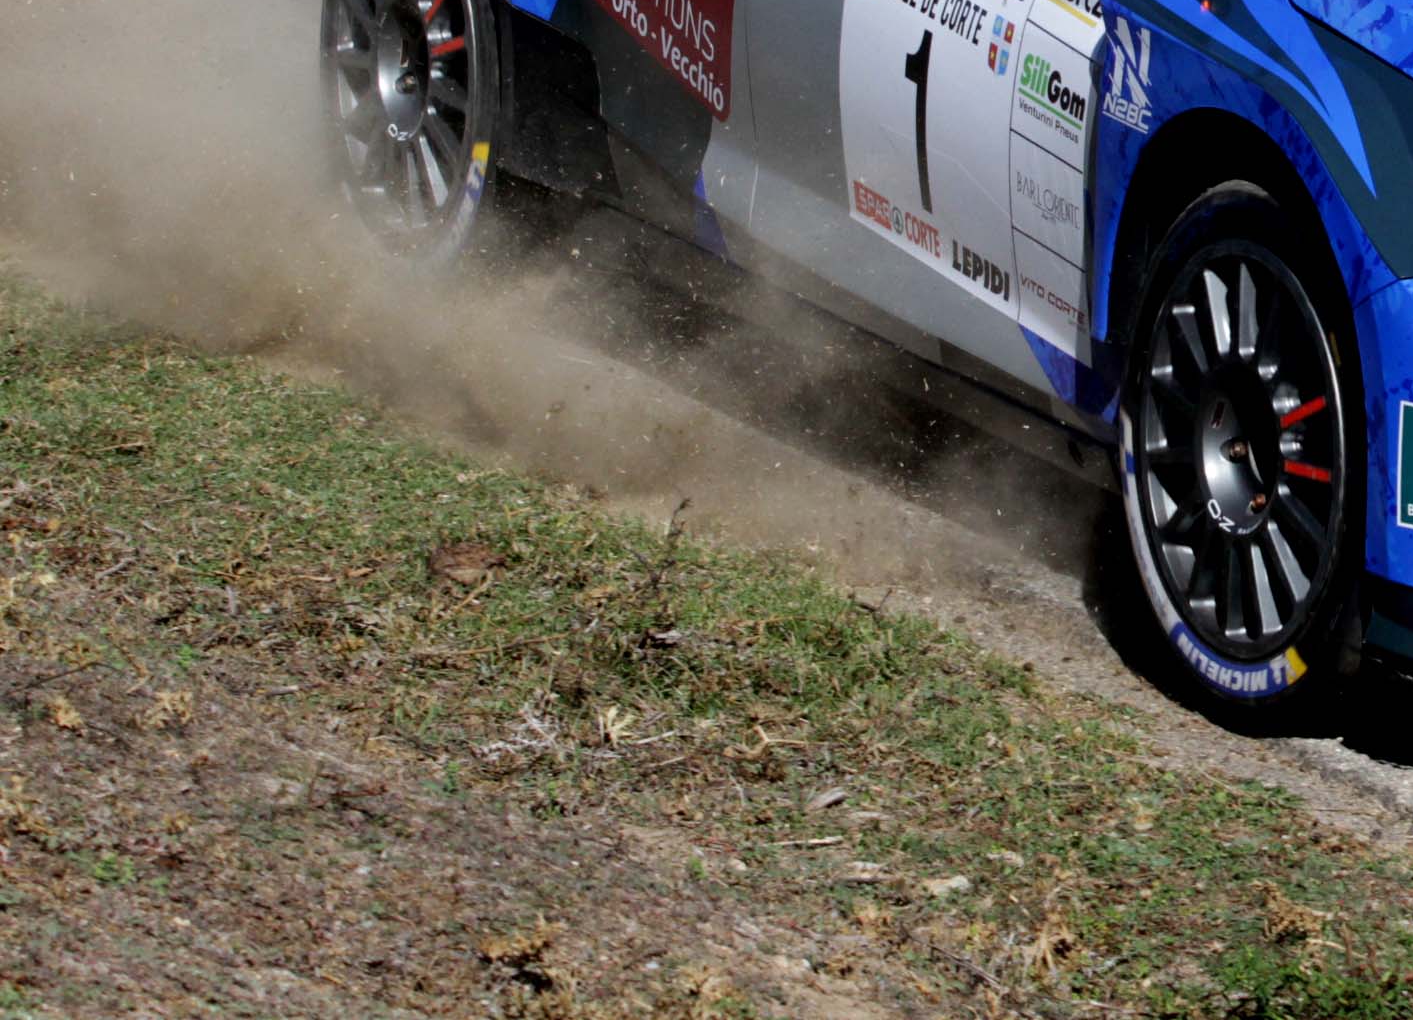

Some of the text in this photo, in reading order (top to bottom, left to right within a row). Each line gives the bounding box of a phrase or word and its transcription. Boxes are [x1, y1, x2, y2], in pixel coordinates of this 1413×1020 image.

[661, 27, 725, 112] Vecchio
[1020, 53, 1086, 122] SiliGom
[905, 30, 934, 215] 1
[1055, 119, 1079, 144] Pneus
[904, 211, 941, 259] CORTE
[952, 239, 1010, 301] LEPIDI
[1177, 632, 1268, 692] MICHELIN
